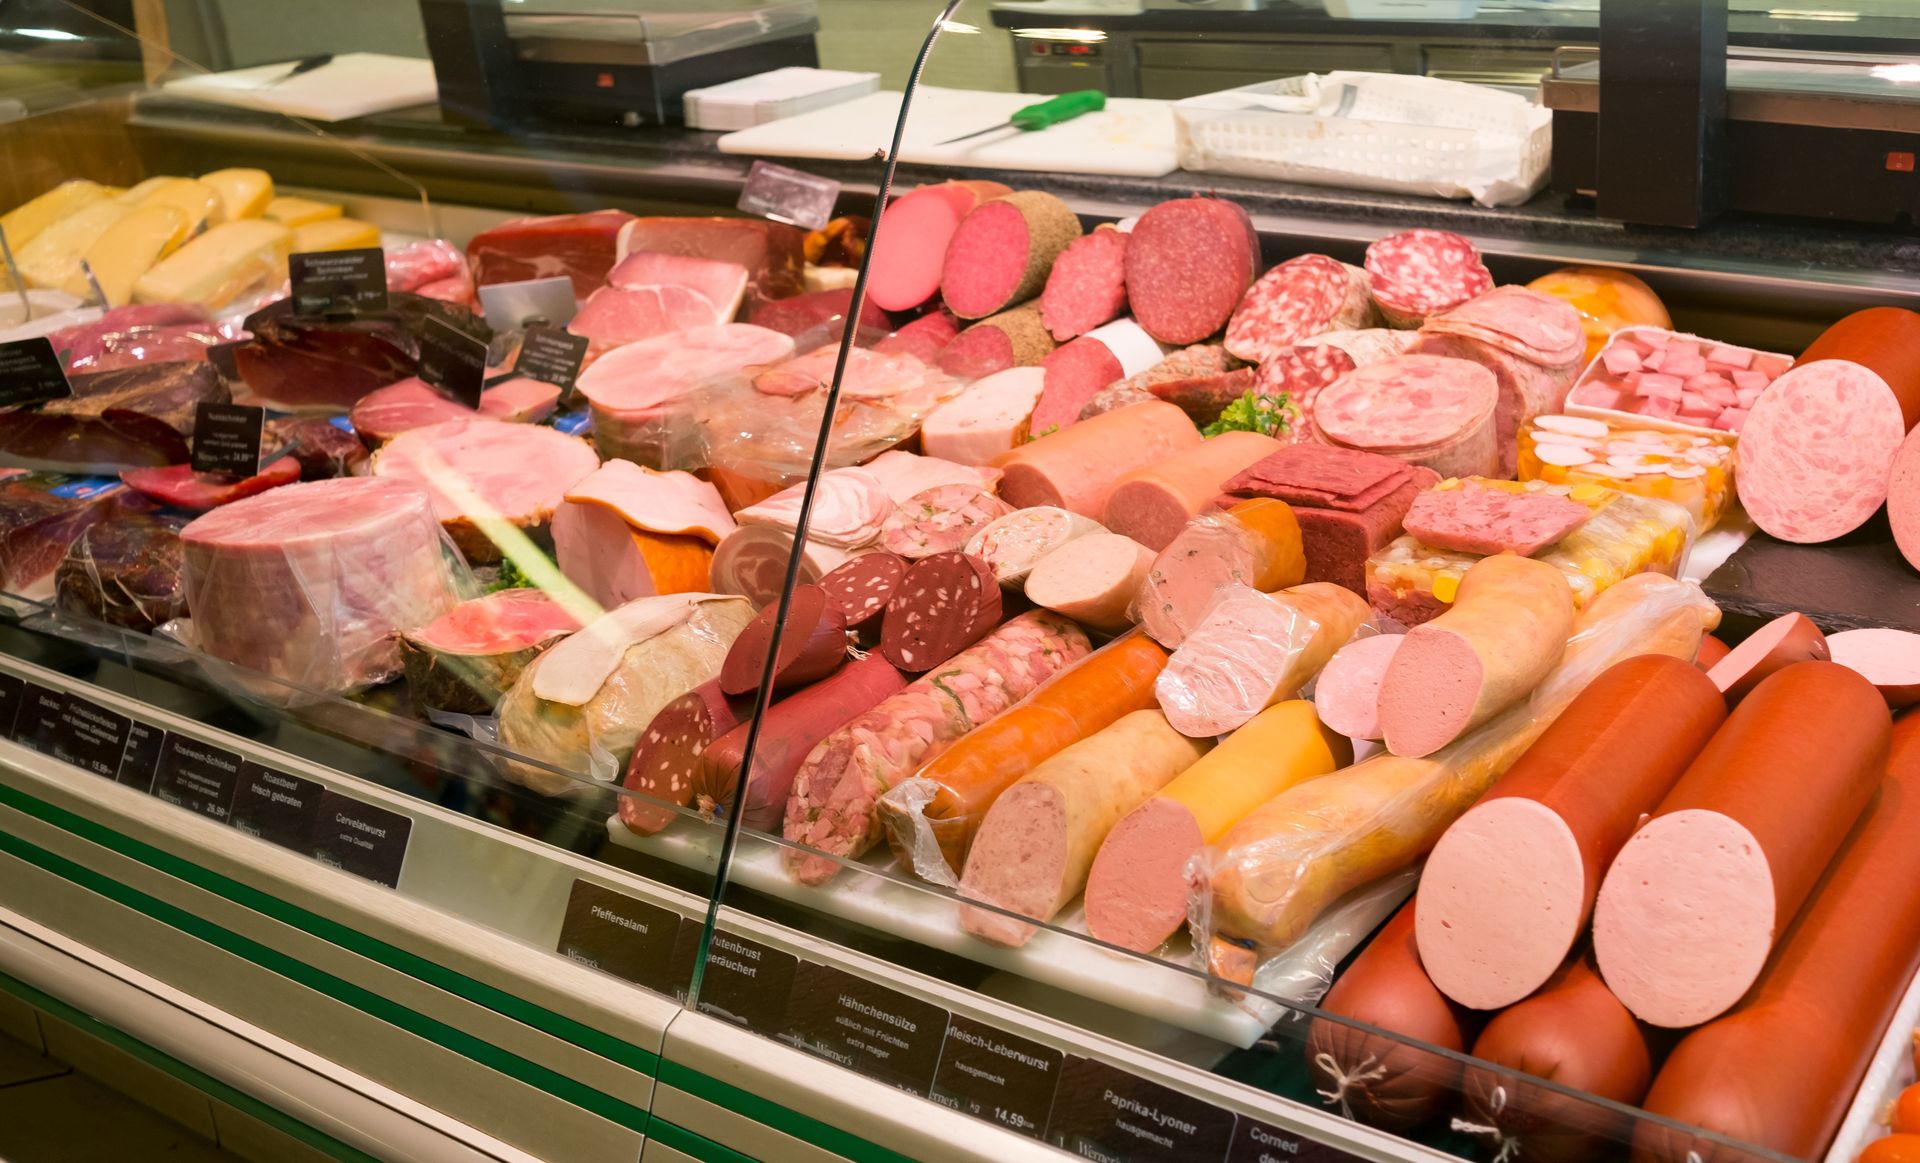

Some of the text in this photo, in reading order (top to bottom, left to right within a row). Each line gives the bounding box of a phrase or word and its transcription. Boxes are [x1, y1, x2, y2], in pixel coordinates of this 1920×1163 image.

[263, 771, 298, 791] Roastbeef
[251, 783, 302, 808] frisch gebraten
[335, 812, 386, 839] Cervelatwurst
[591, 905, 649, 935] Pfeffersalami
[838, 993, 917, 1033] Hähnchensülze
[846, 1036, 890, 1059] extra mager
[863, 1024, 875, 1038] mit
[876, 1030, 909, 1050] Früchten
[946, 1026, 1049, 1071] fleisch-Leberwurst
[955, 1060, 1005, 1086] hausgemacht
[970, 1100, 981, 1114] kg
[1103, 1089, 1197, 1136] Paprika-Lyoner
[1115, 1118, 1174, 1149] hausgemacht
[1250, 1126, 1299, 1154] Corned
